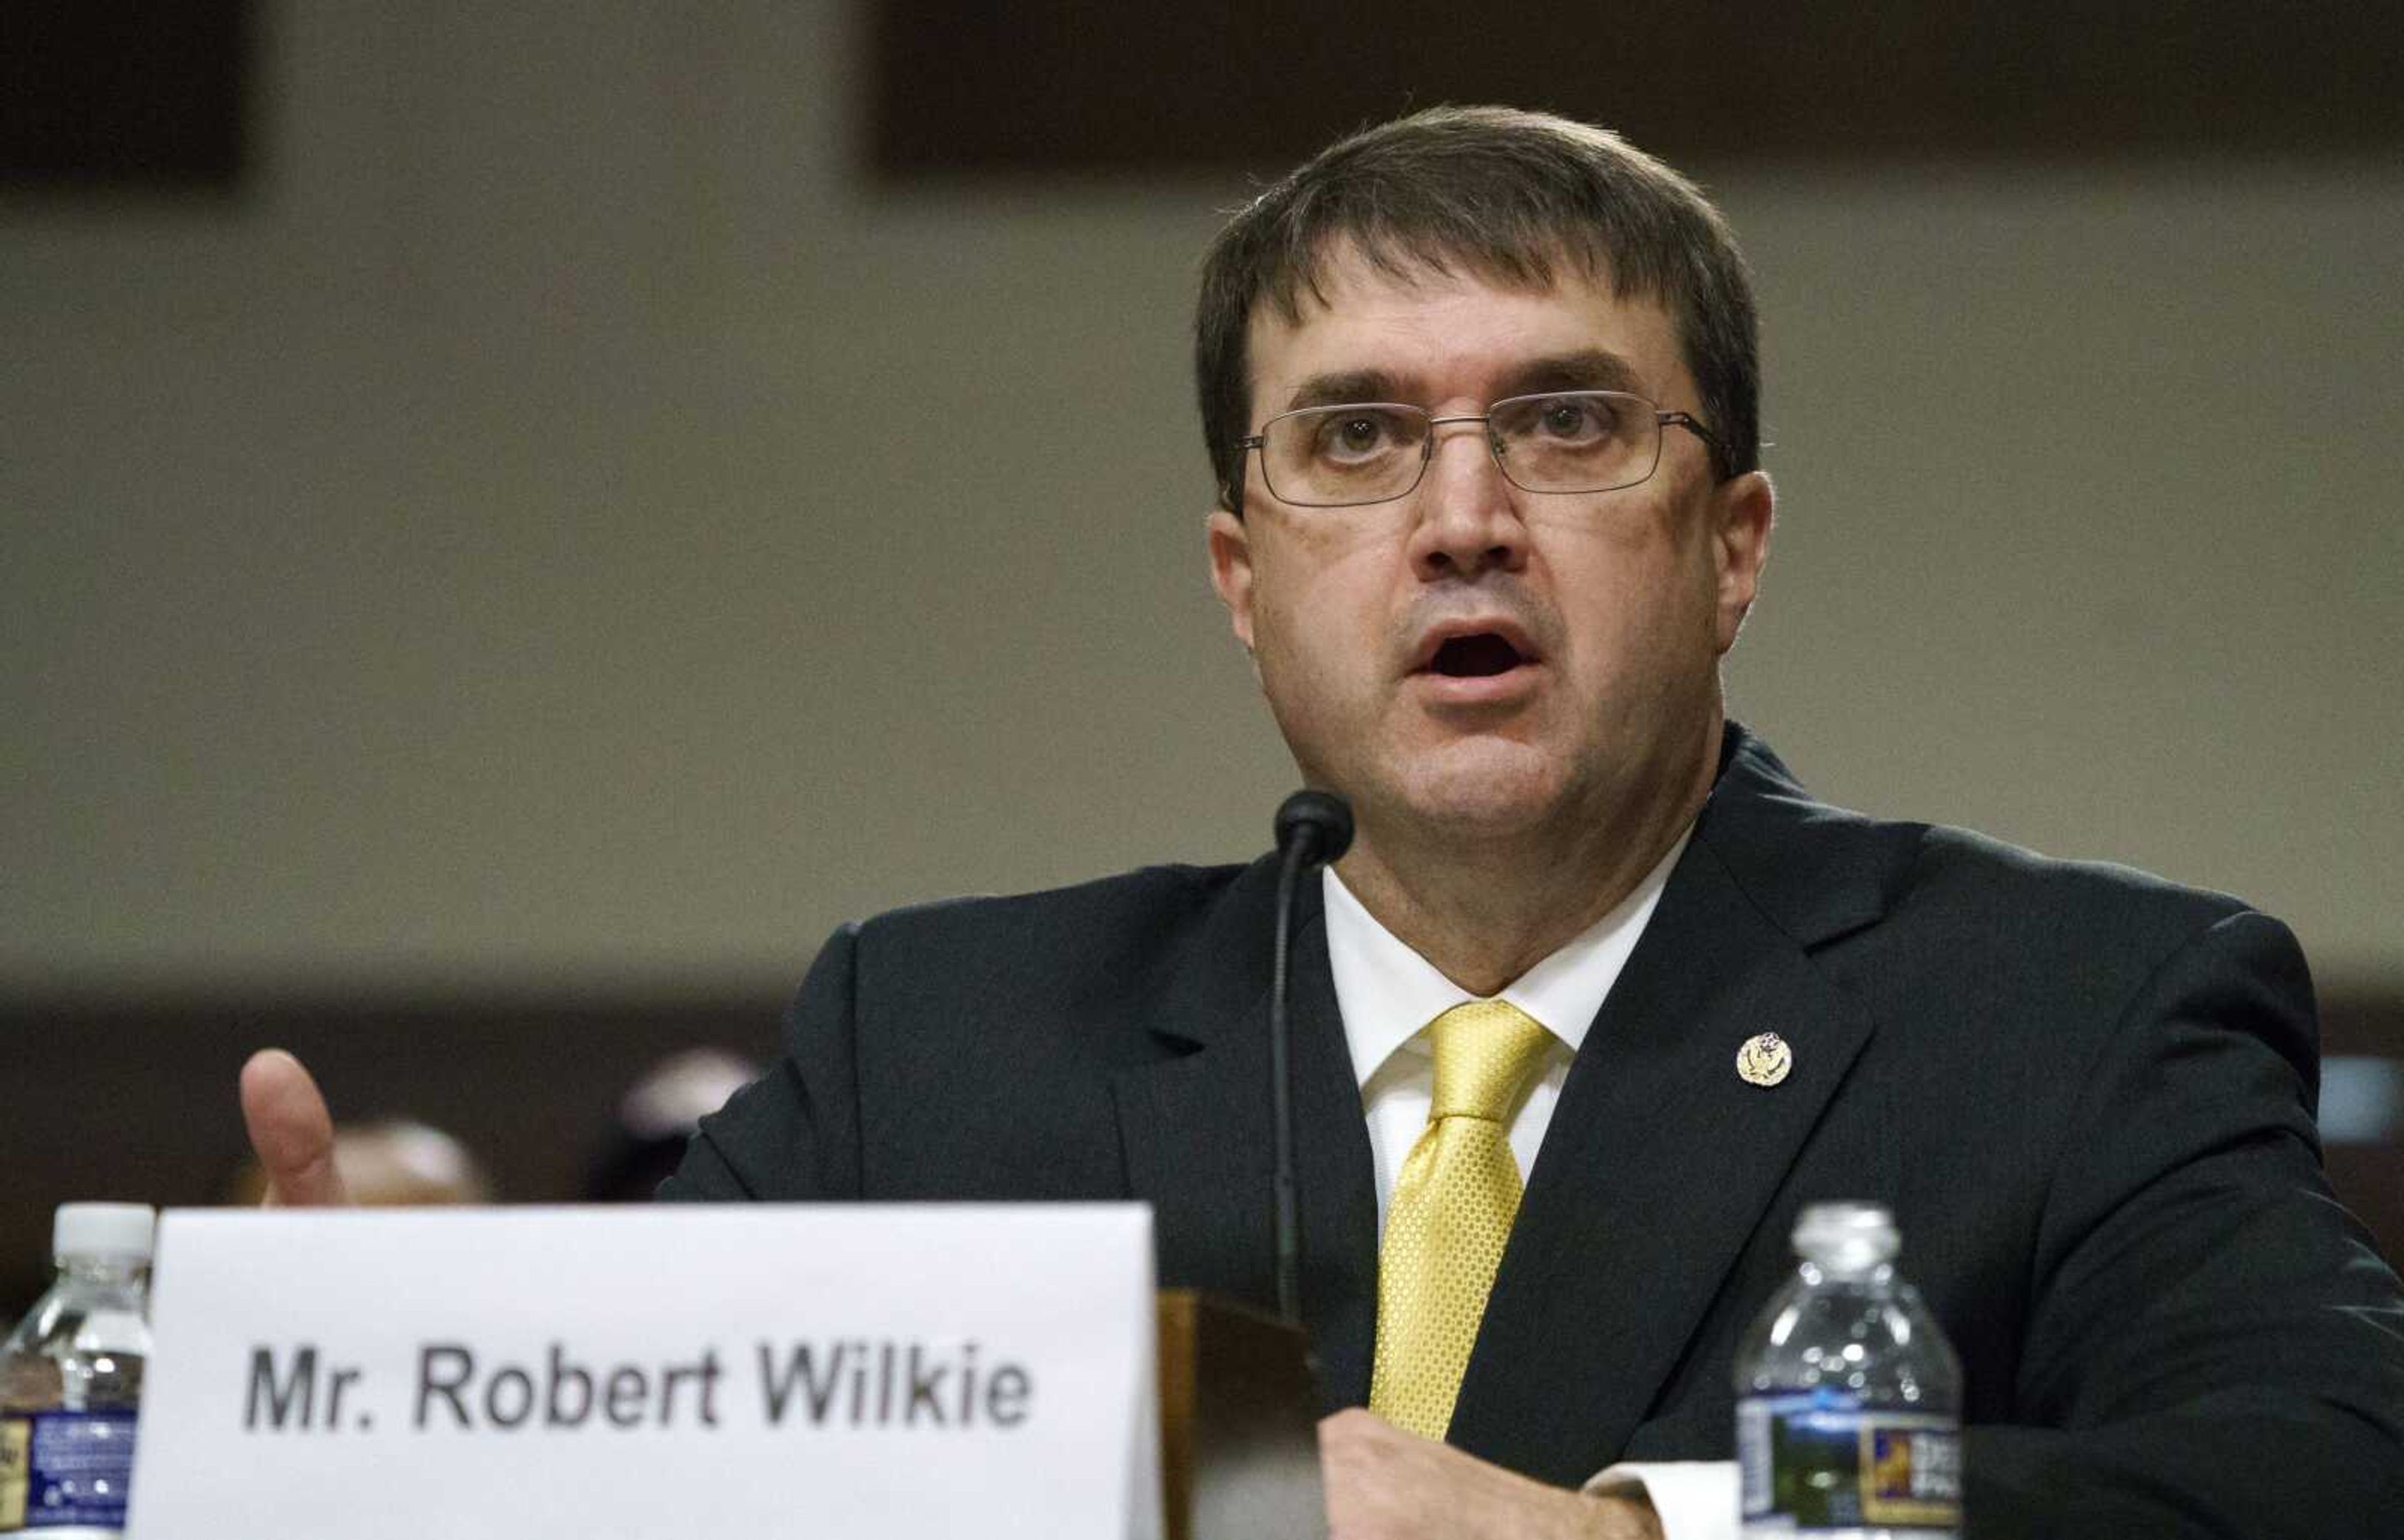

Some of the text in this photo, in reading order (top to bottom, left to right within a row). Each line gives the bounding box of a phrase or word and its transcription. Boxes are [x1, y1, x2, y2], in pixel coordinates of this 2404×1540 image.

[244, 1342, 1031, 1432] Mr. Robert Wilkie
